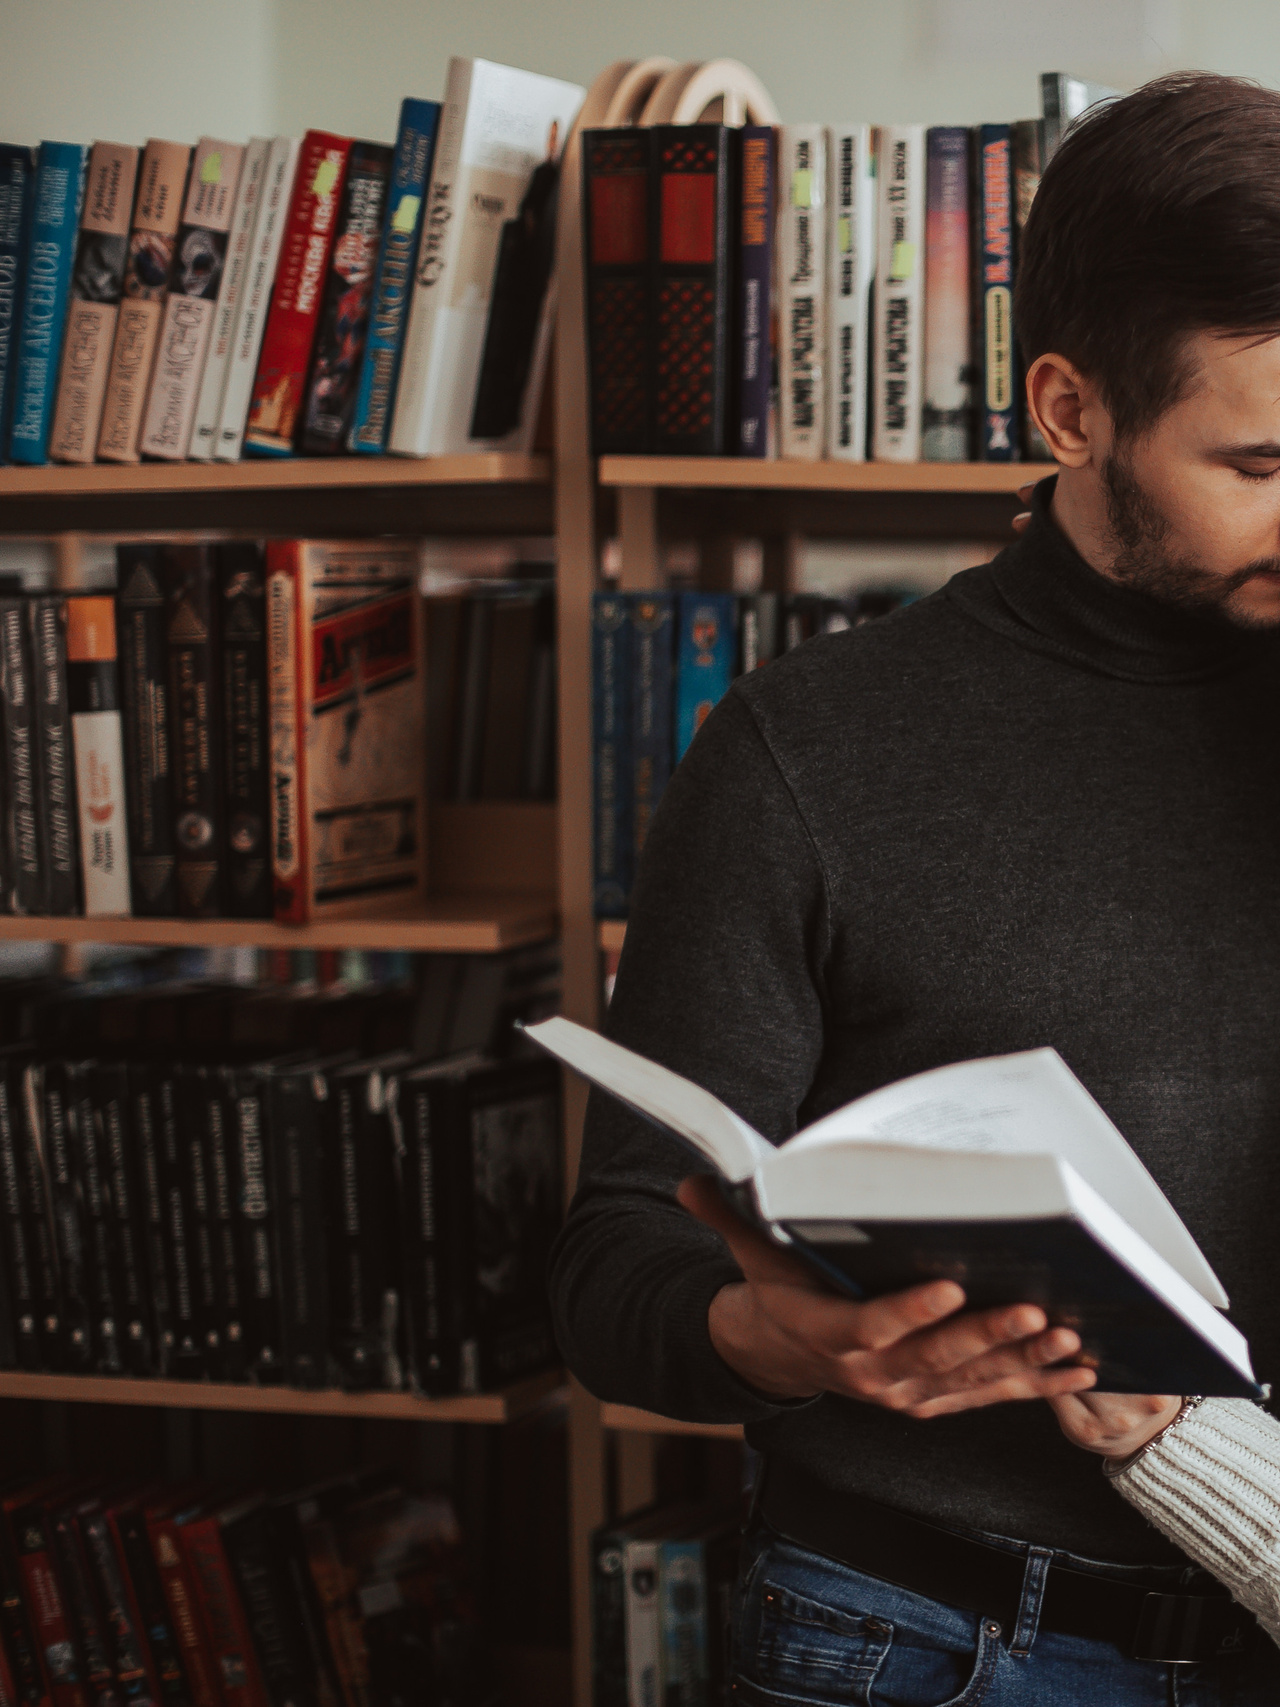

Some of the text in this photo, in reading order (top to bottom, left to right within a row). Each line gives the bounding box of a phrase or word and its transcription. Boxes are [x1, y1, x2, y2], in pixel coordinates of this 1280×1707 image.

[372, 213, 417, 341] АКСЕНО
[414, 180, 454, 289] Сундук
[21, 240, 61, 354] АКСЕНОВ
